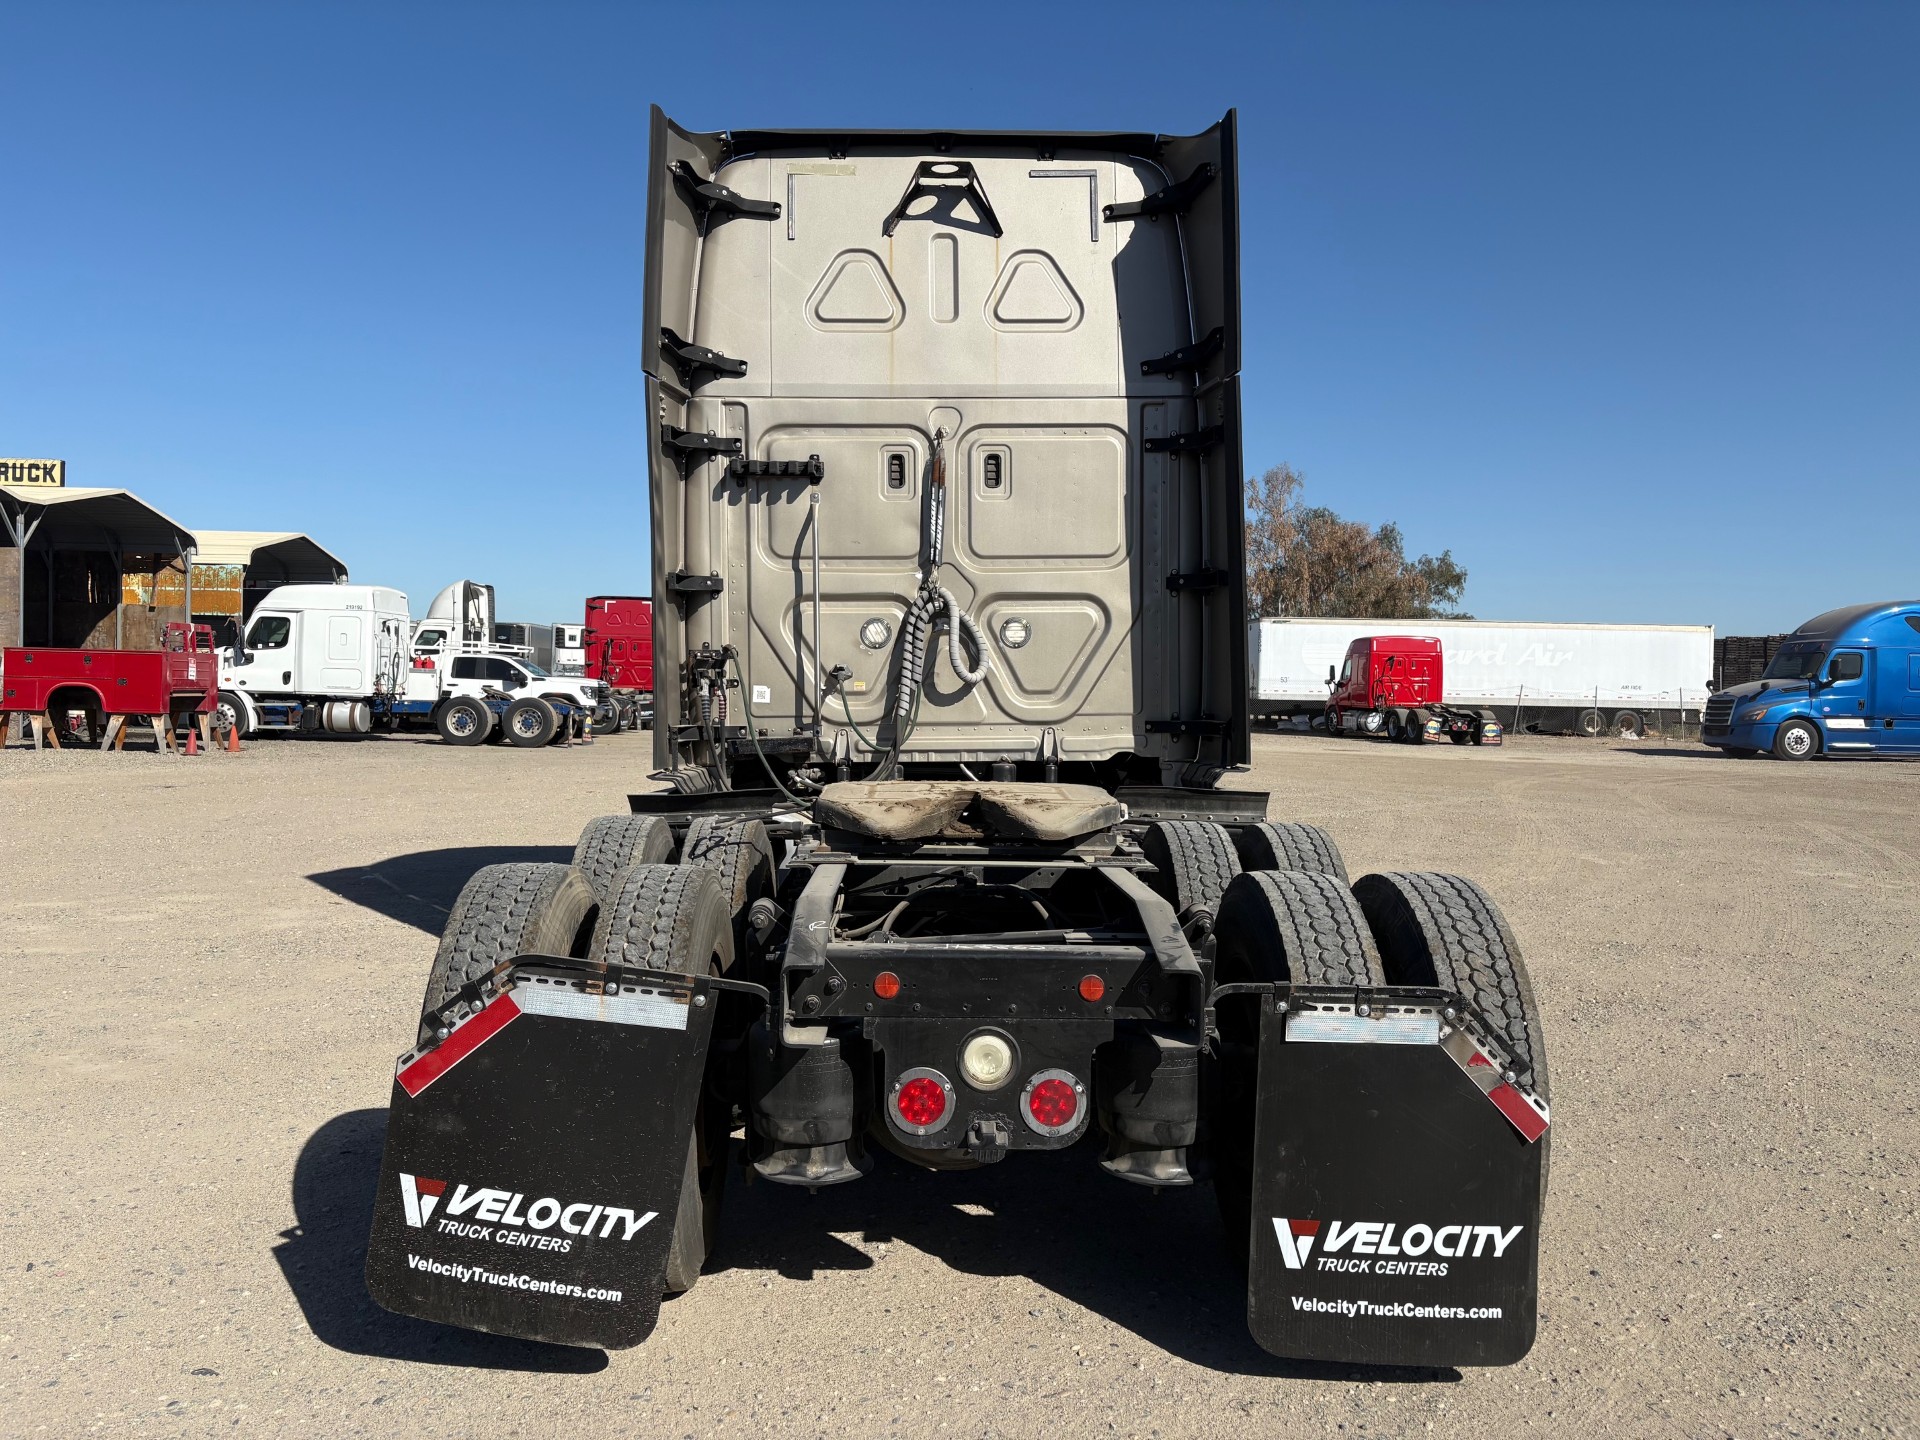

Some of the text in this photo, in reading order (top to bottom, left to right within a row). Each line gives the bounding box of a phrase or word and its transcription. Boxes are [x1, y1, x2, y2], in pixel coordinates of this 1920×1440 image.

[1516, 642, 1574, 667] Air
[446, 1183, 660, 1241] VELOCITY
[437, 1218, 573, 1253] TRUCK CENTERS
[1322, 1220, 1524, 1258] VELOCITY
[408, 1254, 622, 1302] VelocityTruckCenters.com
[1316, 1257, 1449, 1277] TRUCK CENTERS
[1291, 1296, 1503, 1319] VelocityTruckCenters.com
